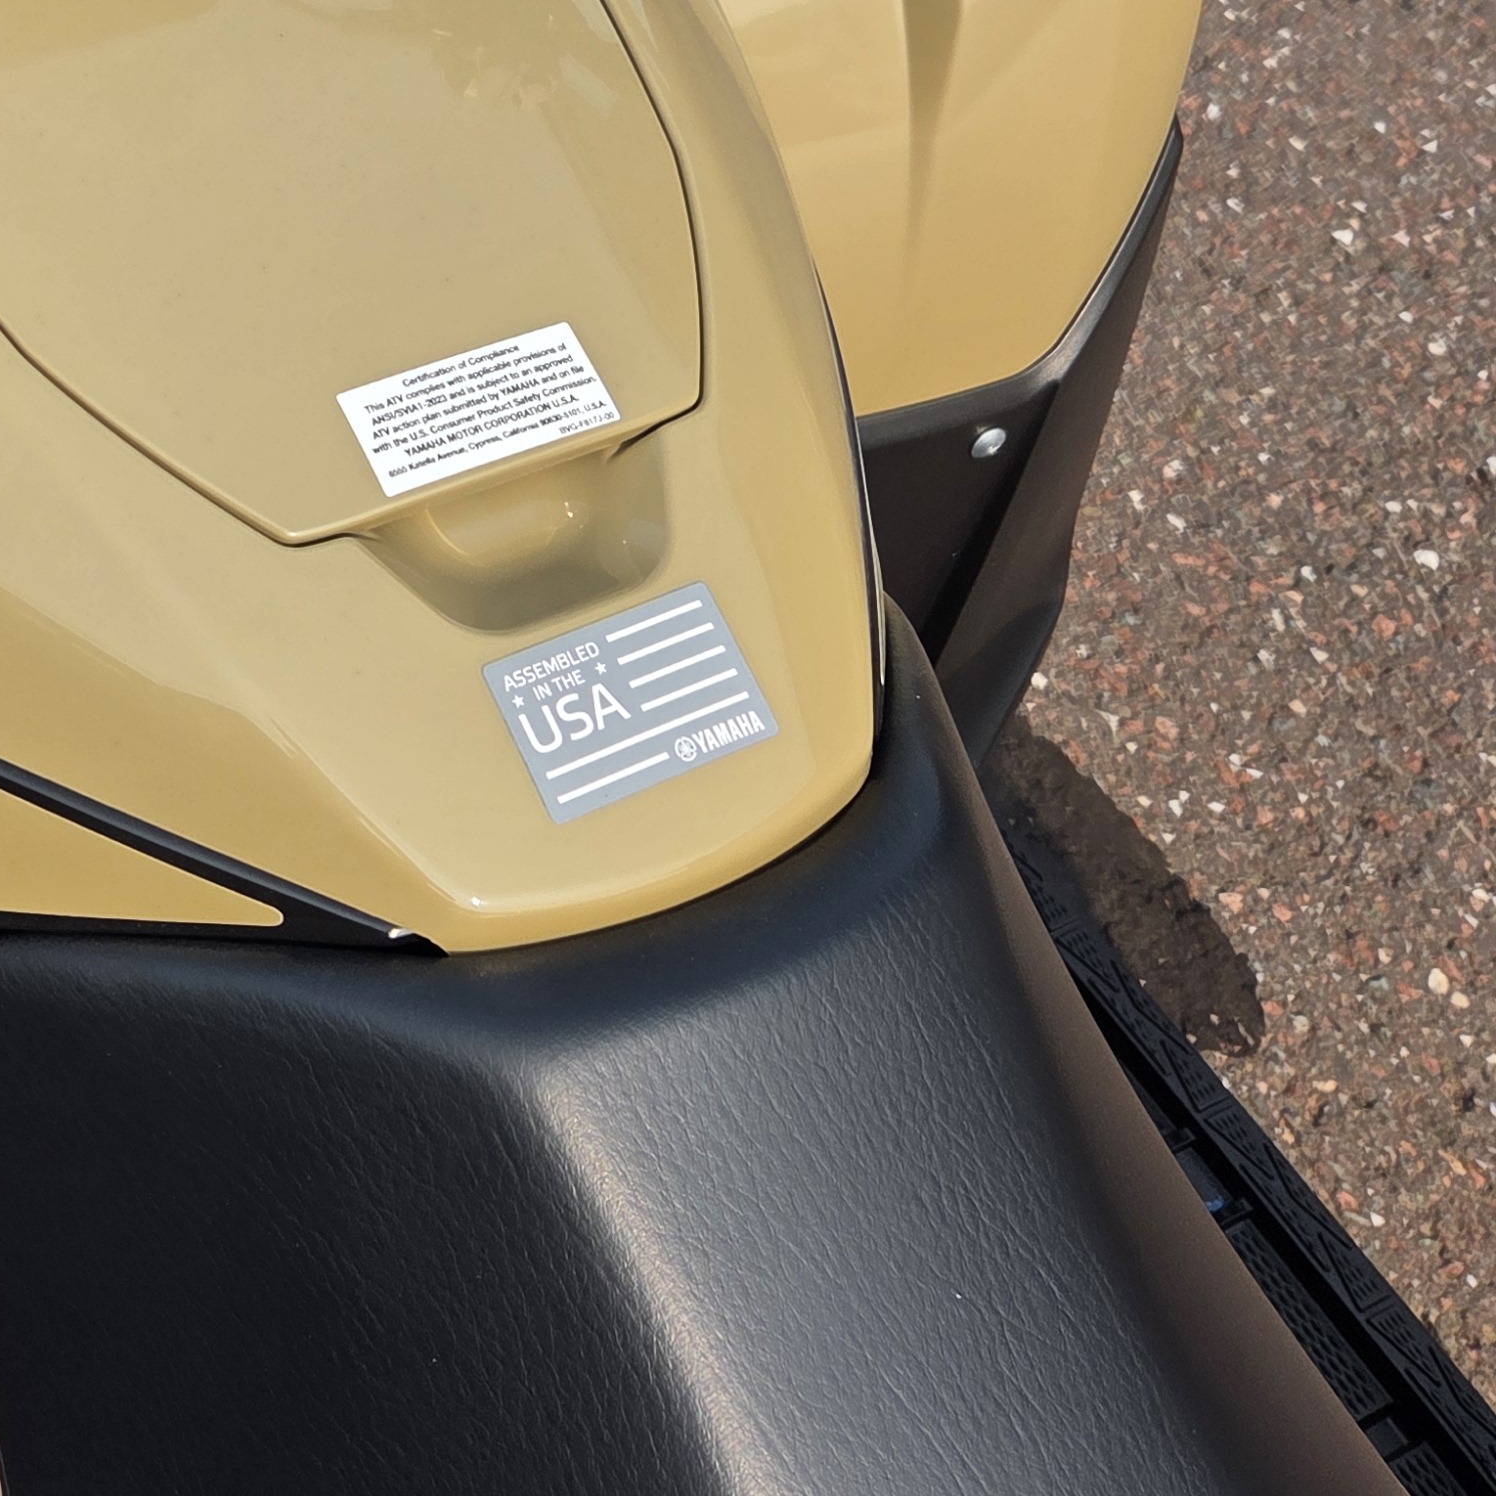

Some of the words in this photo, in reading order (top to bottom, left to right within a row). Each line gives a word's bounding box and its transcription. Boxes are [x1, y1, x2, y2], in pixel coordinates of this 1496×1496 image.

[503, 641, 600, 693] ASSEMBLED
[532, 682, 553, 701] IN
[550, 669, 586, 692] THE
[518, 683, 632, 754] USA
[690, 710, 766, 754] YAMAHA
